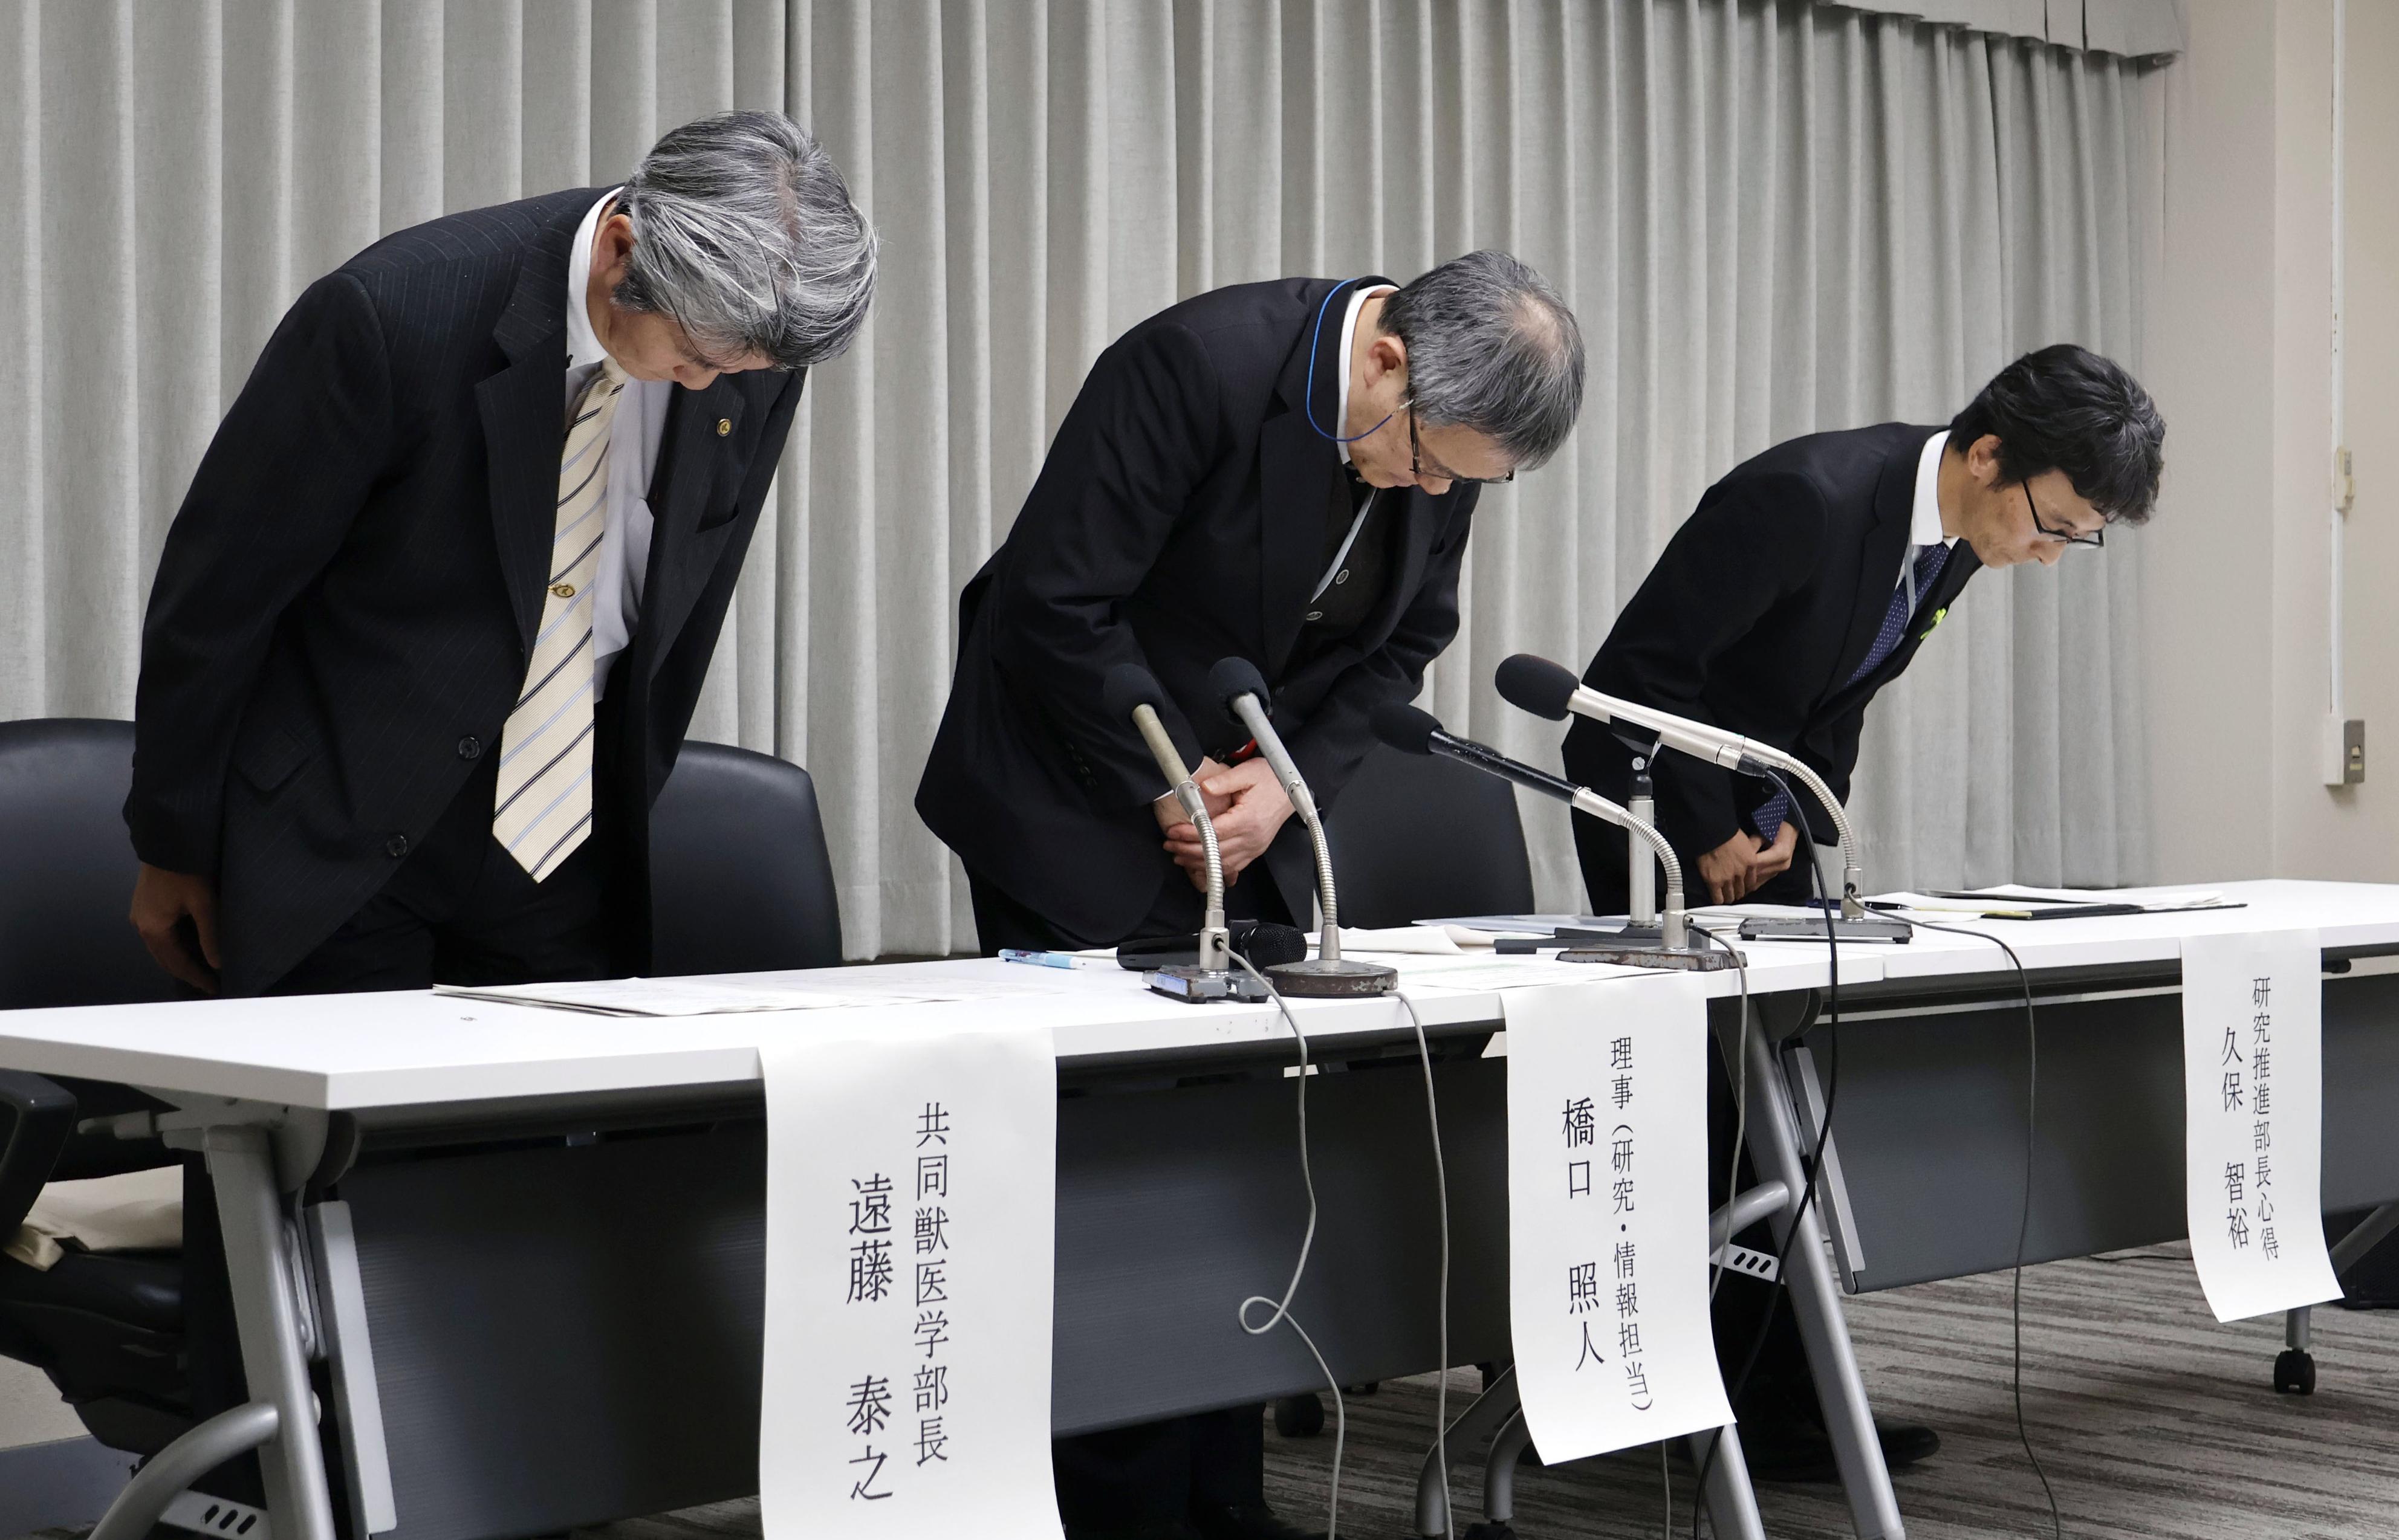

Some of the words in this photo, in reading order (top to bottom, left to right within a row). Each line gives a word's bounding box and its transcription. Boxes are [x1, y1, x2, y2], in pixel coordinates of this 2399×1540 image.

[2221, 1026, 2244, 1113] 久保
[2251, 976, 2279, 1261] 研究推進部長心得
[1562, 1096, 1595, 1200] 橋口
[2224, 1162, 2250, 1250] 智裕
[846, 1172, 894, 1305] 遠藤
[913, 1101, 950, 1467] 共同獣医学部長
[1569, 1261, 1605, 1372] 照人
[846, 1374, 894, 1501] 泰之
